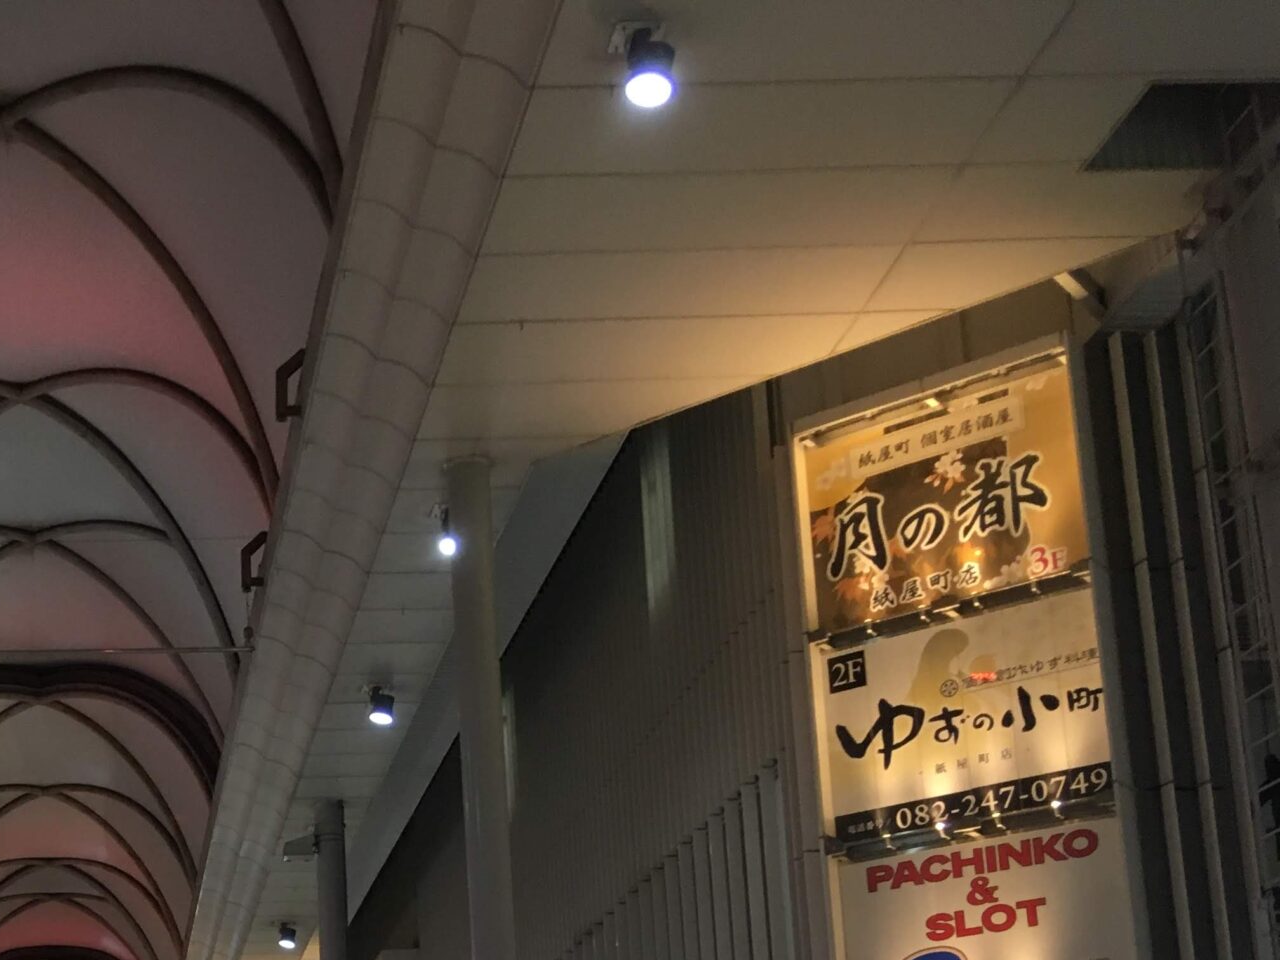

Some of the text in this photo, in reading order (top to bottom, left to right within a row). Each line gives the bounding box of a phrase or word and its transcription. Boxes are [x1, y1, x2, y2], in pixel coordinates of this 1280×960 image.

[829, 455, 1048, 580] 月の都
[1030, 546, 1065, 575] 3F
[872, 564, 981, 609] 紙屋町店
[831, 657, 863, 686] 2F
[836, 686, 1104, 770] ゆずの小町
[895, 768, 1108, 830] 082-247-0749
[867, 828, 1099, 893] PACHINKO
[966, 876, 999, 906] &
[926, 897, 1047, 941] SLOT
